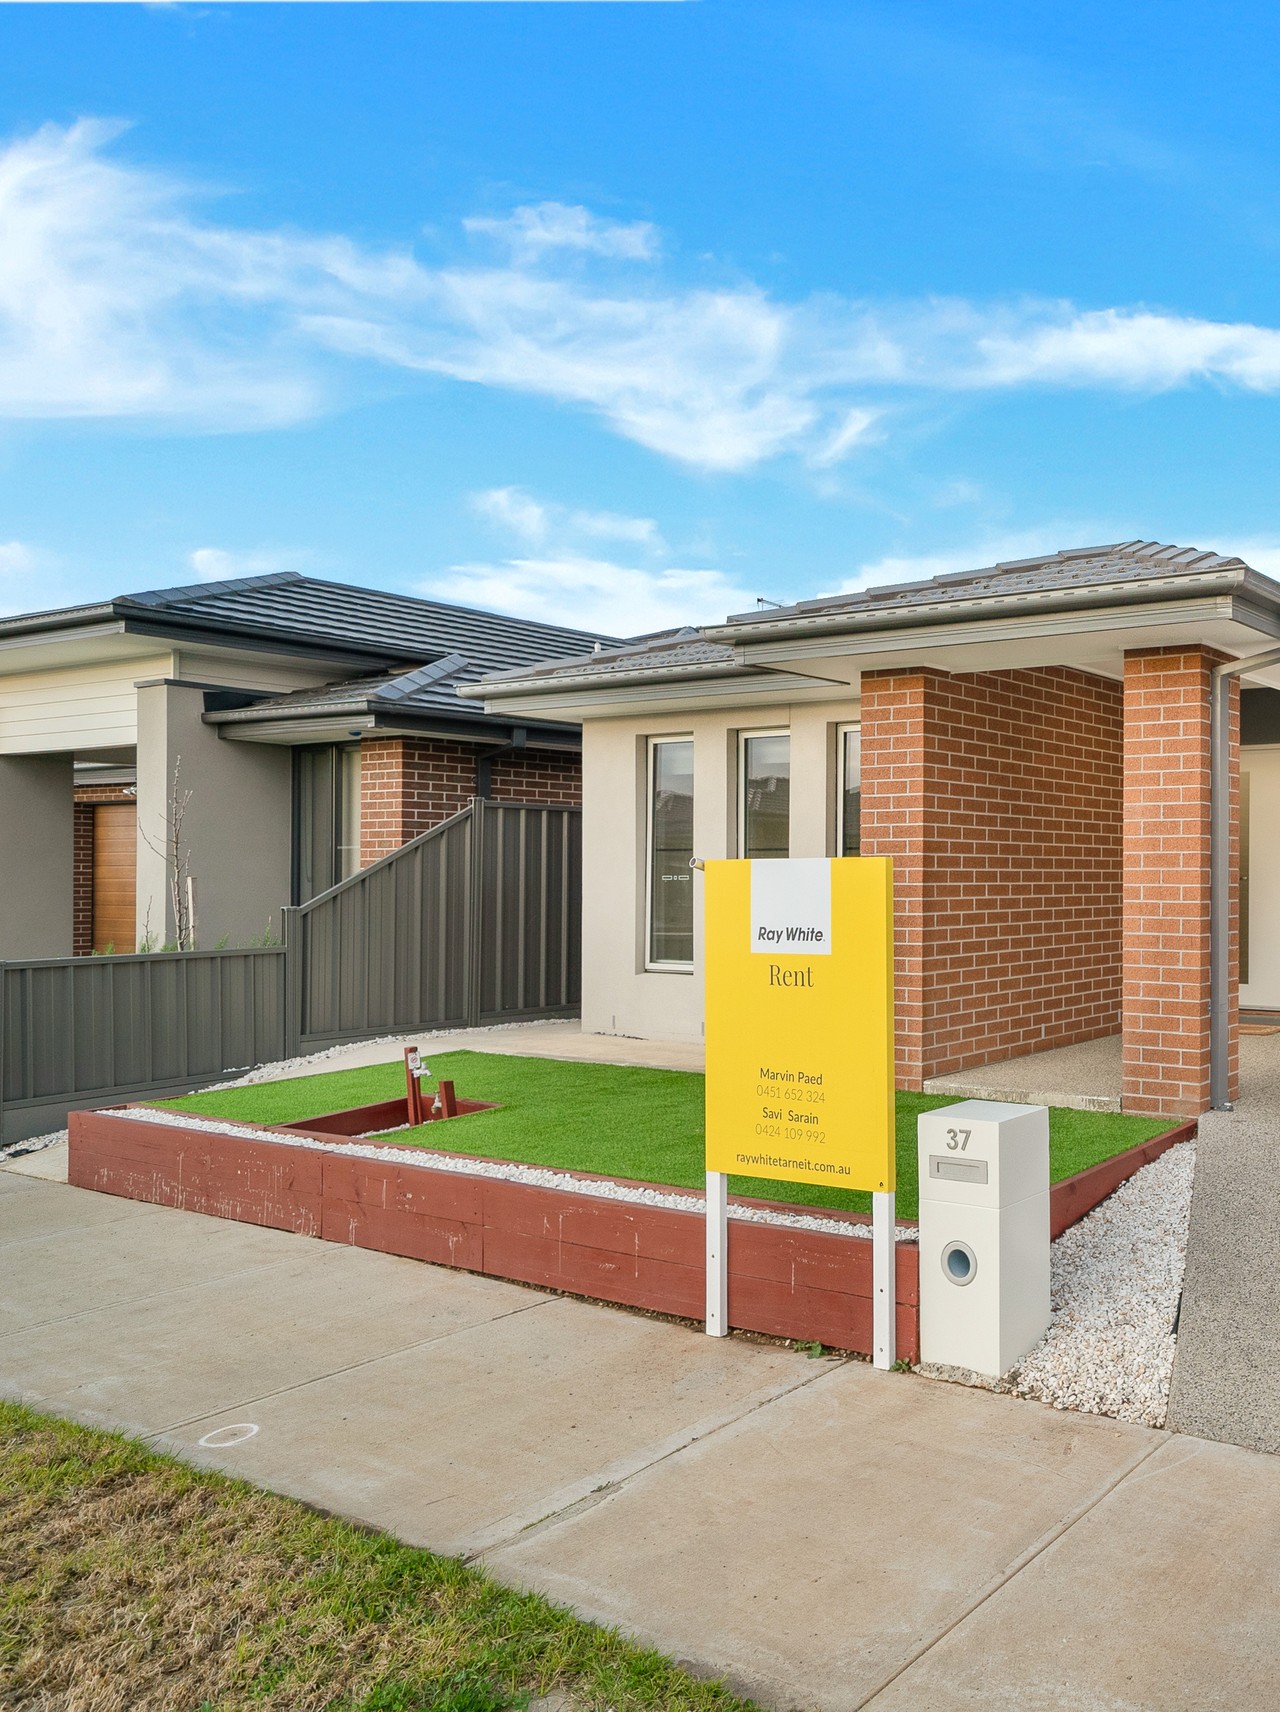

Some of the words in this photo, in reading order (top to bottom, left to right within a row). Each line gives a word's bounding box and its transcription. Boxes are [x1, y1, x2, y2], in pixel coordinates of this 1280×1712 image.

[758, 926, 783, 944] Ray
[769, 964, 815, 988] Rent
[760, 1067, 795, 1083] Marvin
[797, 1071, 823, 1085] Paed
[756, 1084, 781, 1099] 0451
[784, 1088, 803, 1101] 652
[806, 1091, 826, 1104] 324
[762, 1106, 782, 1120] Savi
[788, 1109, 819, 1125] Sarain
[755, 1123, 781, 1137] 0424
[784, 1127, 803, 1140] 109
[806, 1130, 826, 1144] 992
[946, 1128, 971, 1151] 37
[736, 1152, 851, 1175] raywhitetarneit.com.au
